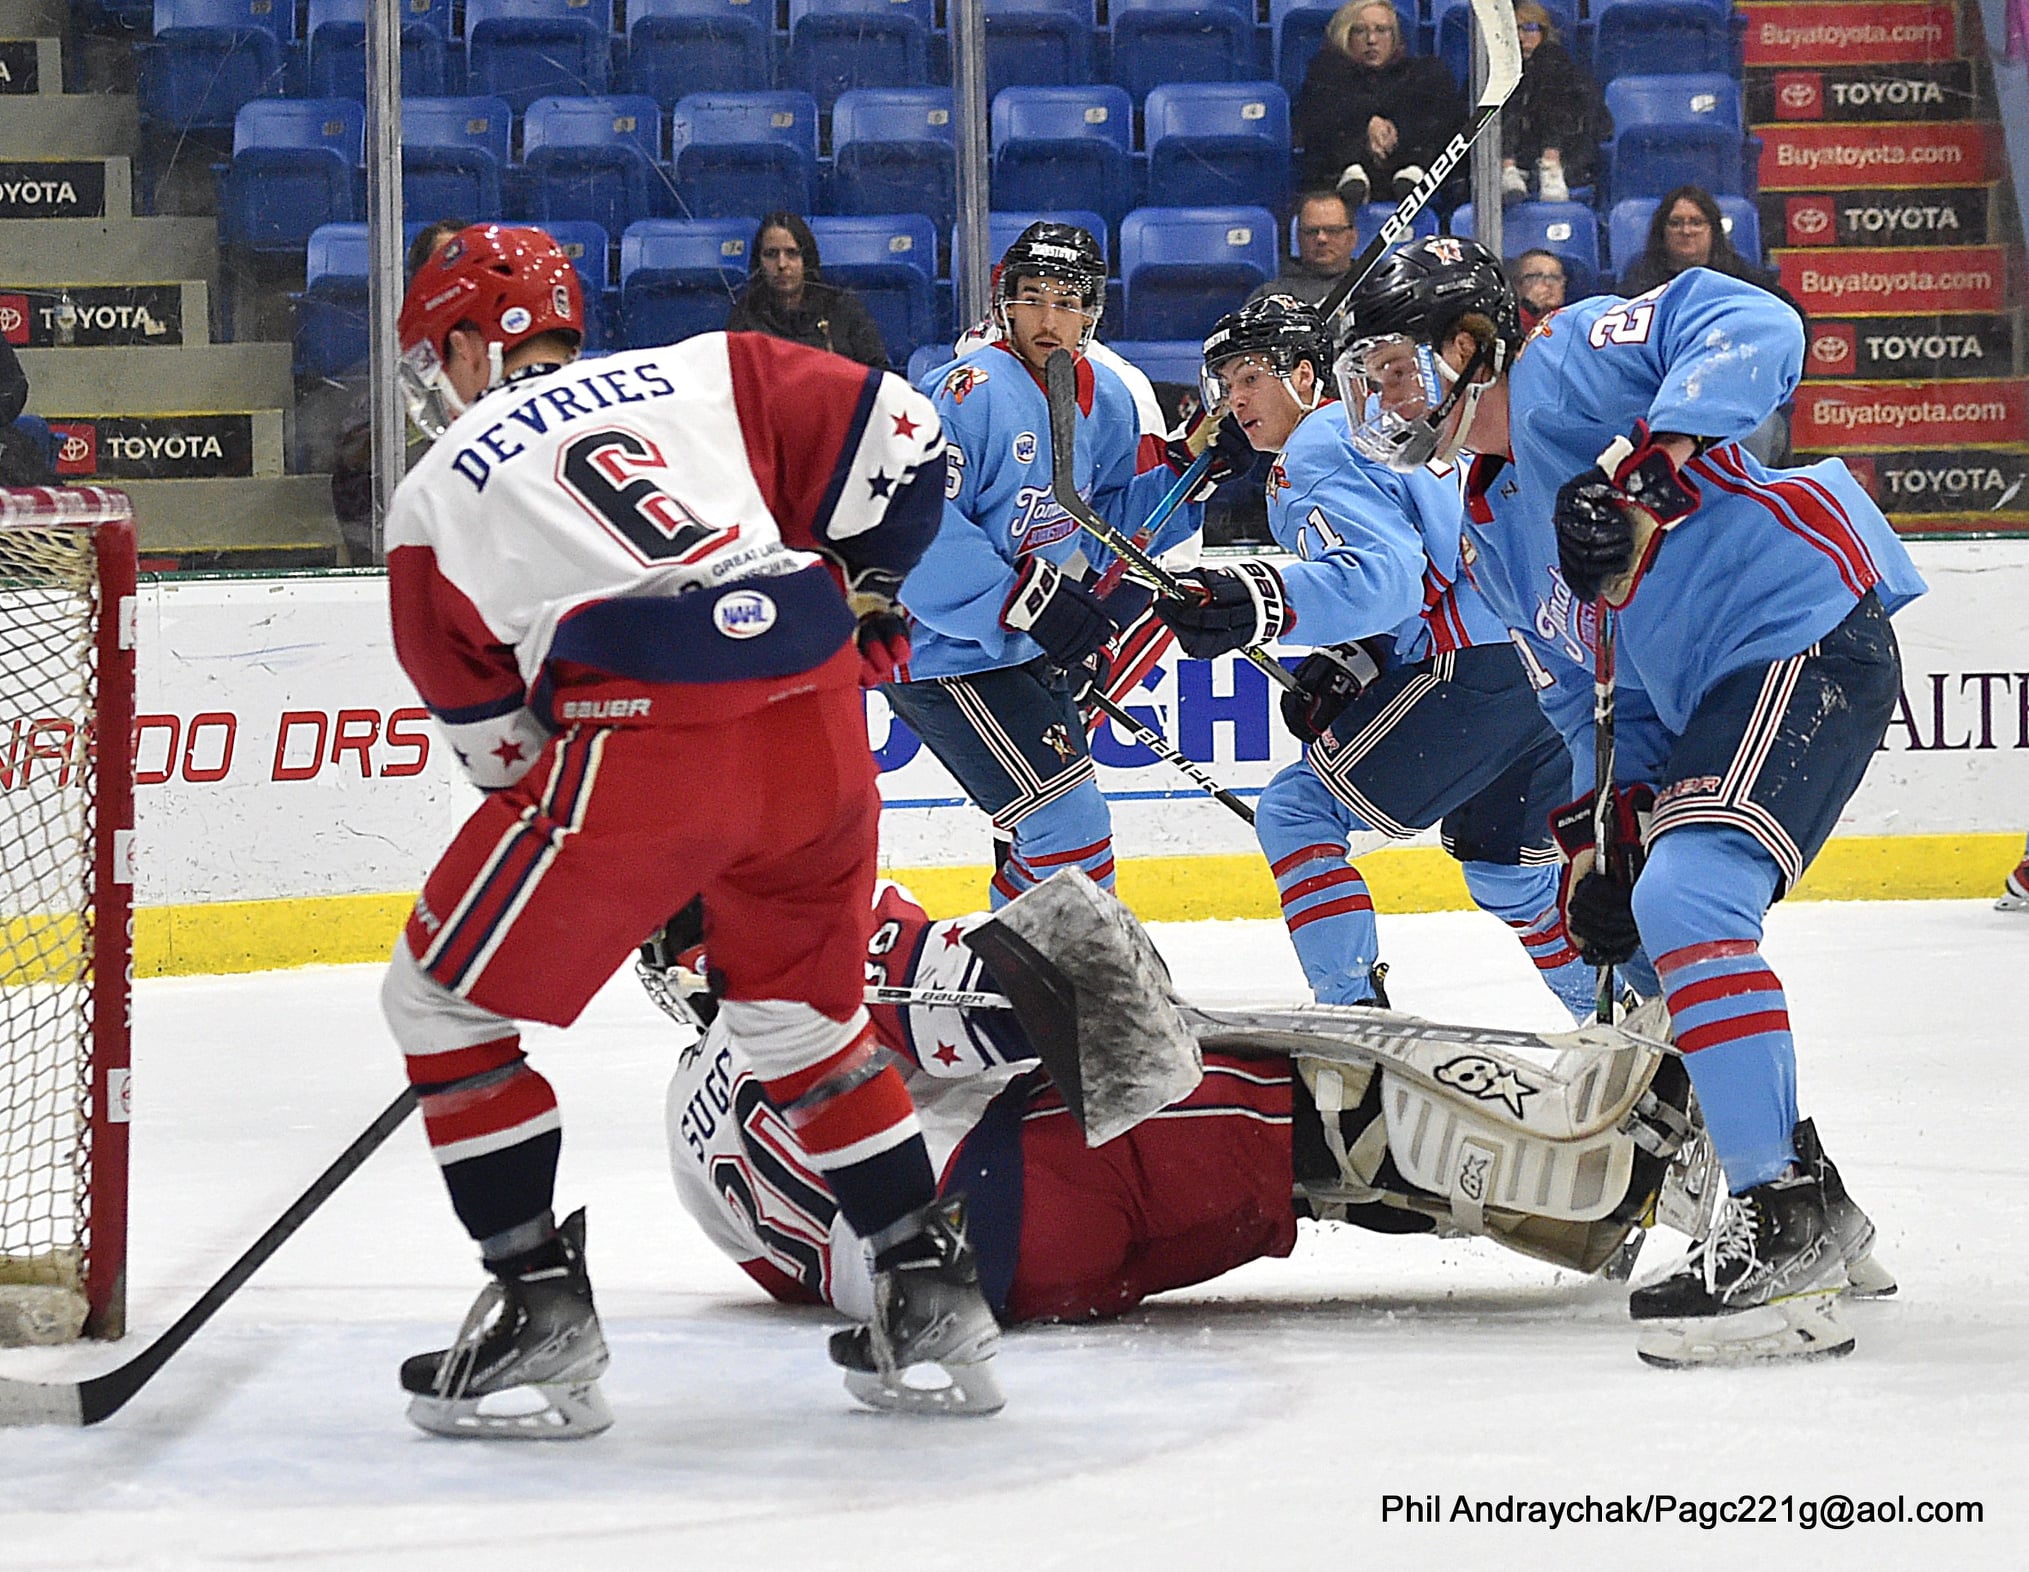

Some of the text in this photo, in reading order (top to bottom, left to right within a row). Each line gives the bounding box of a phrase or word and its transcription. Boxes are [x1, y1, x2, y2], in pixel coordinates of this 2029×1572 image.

[1759, 22, 1942, 49] Buyatoyota.com
[1832, 81, 1944, 106] TOYOTA
[1777, 143, 1962, 170] Buyatoyota.com
[0, 181, 77, 204] YOTA
[1379, 132, 1470, 245] BAUER
[1844, 206, 1959, 232] TOYOTA
[1801, 270, 1992, 297] Buyatoyota.com
[1865, 335, 1983, 360] TOYOTA
[452, 363, 675, 493] DEVRIES
[1812, 401, 2006, 429] Buyatoyota.com
[106, 436, 223, 460] TOYOTA
[1885, 467, 2006, 493] TOYOTA
[555, 425, 740, 569] 6
[562, 698, 652, 719] BAUER
[271, 707, 432, 783] DRS
[1136, 726, 1223, 794] BAUER
[1557, 808, 1591, 829] BAUER
[920, 991, 986, 1004] BAUER
